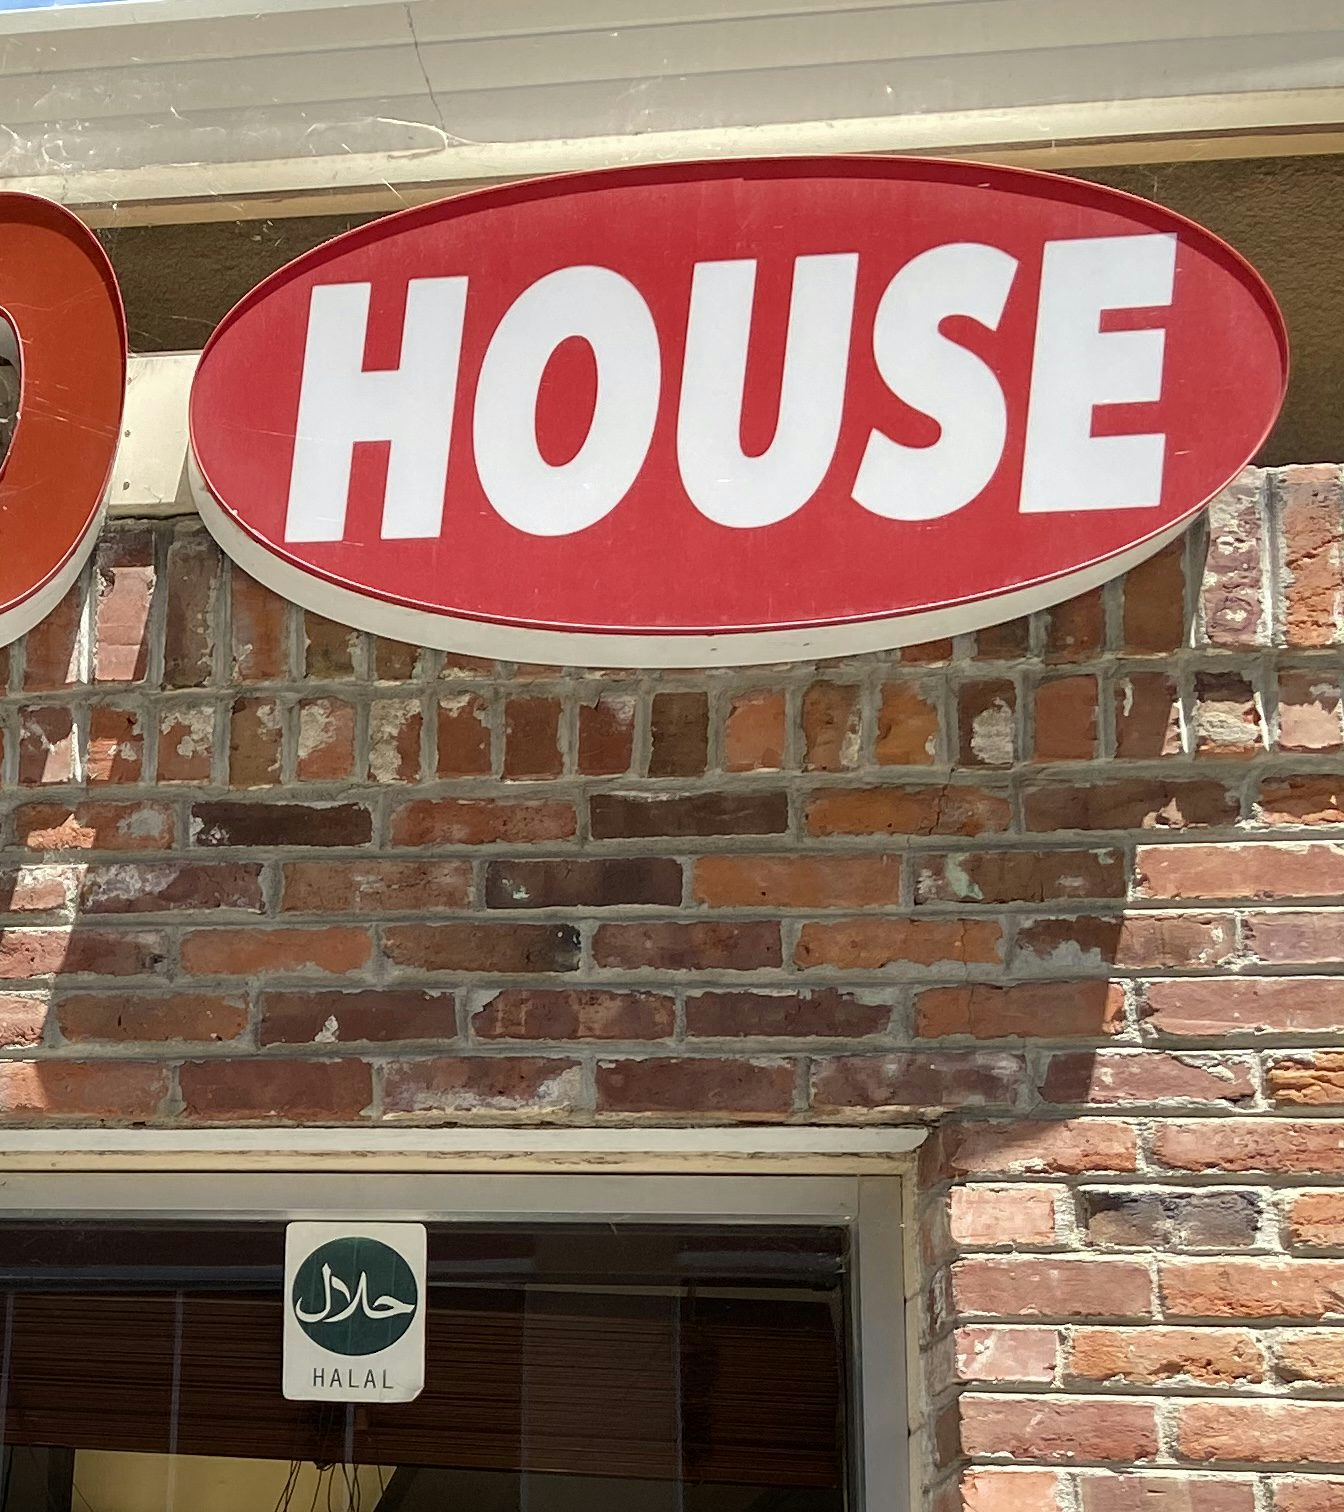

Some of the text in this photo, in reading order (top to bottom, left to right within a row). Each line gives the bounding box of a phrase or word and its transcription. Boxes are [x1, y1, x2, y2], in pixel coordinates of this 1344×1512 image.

[283, 232, 1179, 545] HOUSE
[294, 1263, 416, 1323] حلال
[312, 1367, 395, 1390] HALAL
